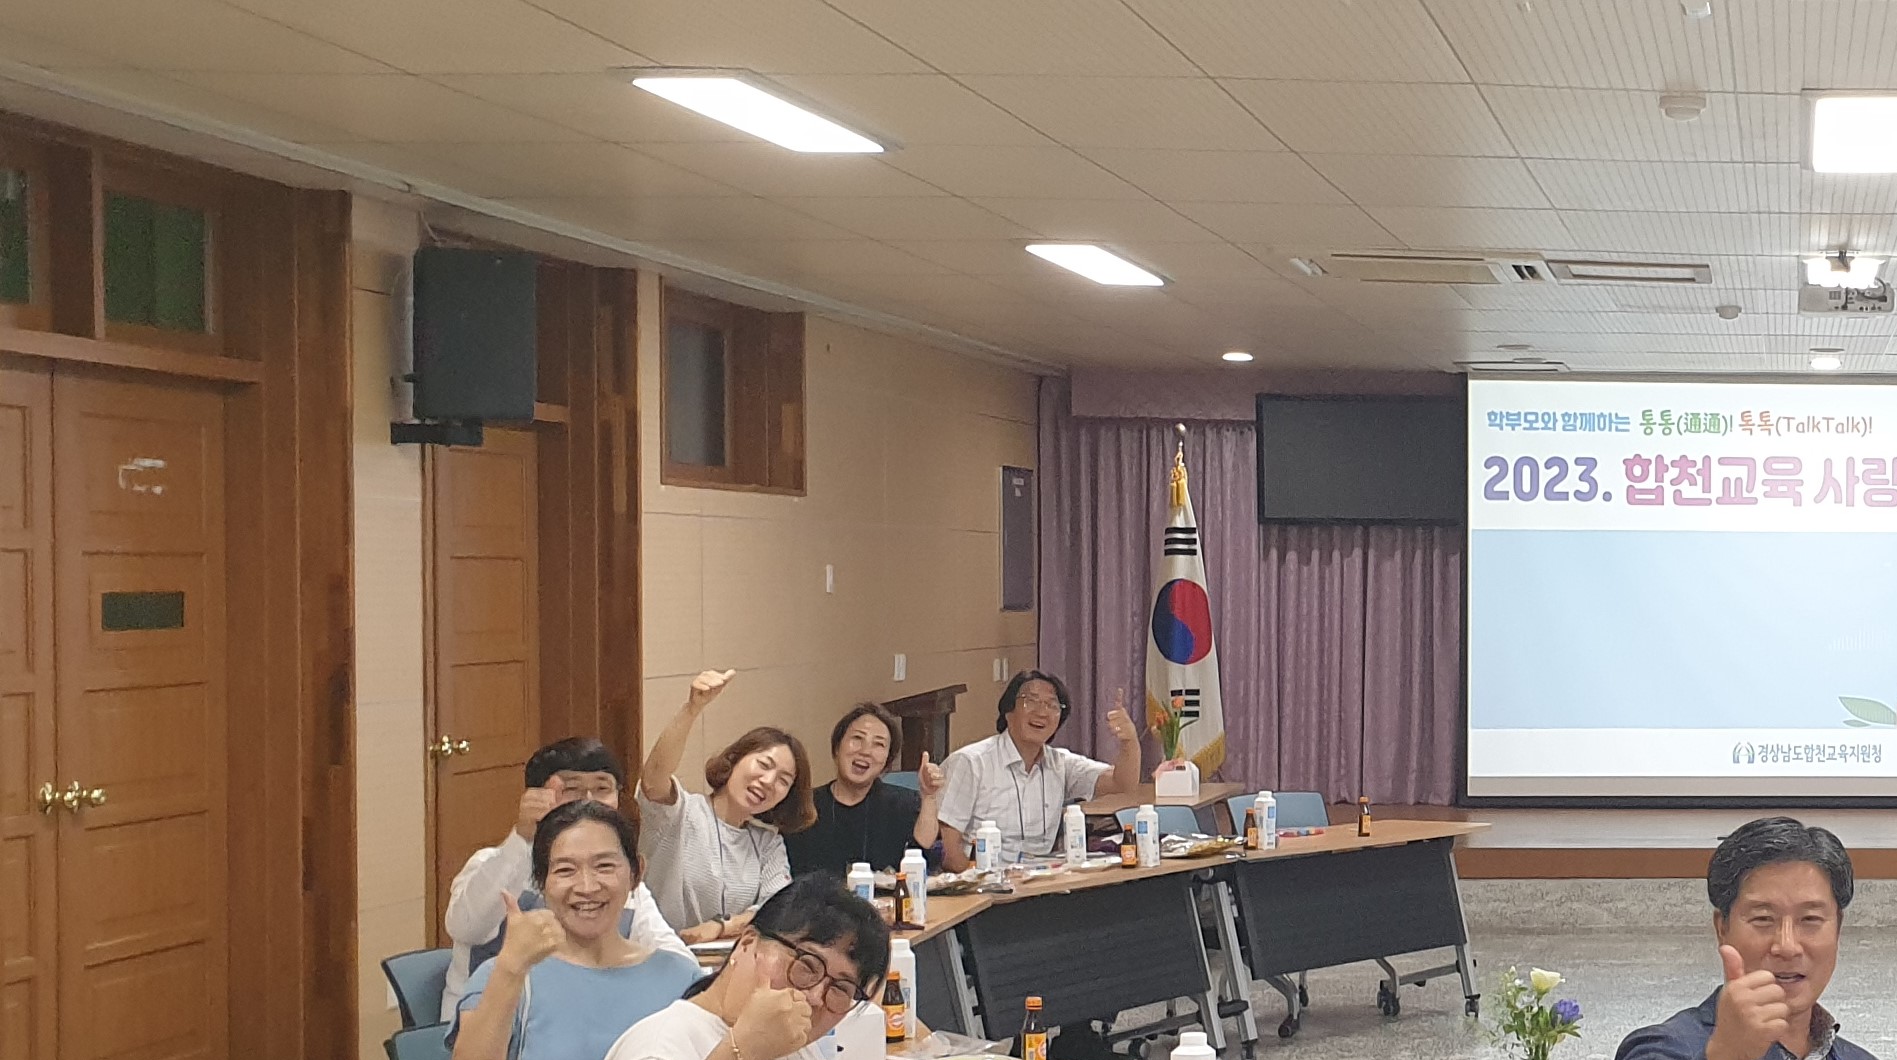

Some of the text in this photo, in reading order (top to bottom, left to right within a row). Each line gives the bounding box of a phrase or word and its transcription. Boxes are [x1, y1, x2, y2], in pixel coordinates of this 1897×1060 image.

[1486, 409, 1873, 437] 학부모와 함께하는 통통(通通)! 톡톡(TalkTalk)!
[1483, 455, 1613, 502] 2023.
[1622, 453, 1805, 507] 합천교육
[1757, 743, 1883, 764] 경상남도합천교육지원청
